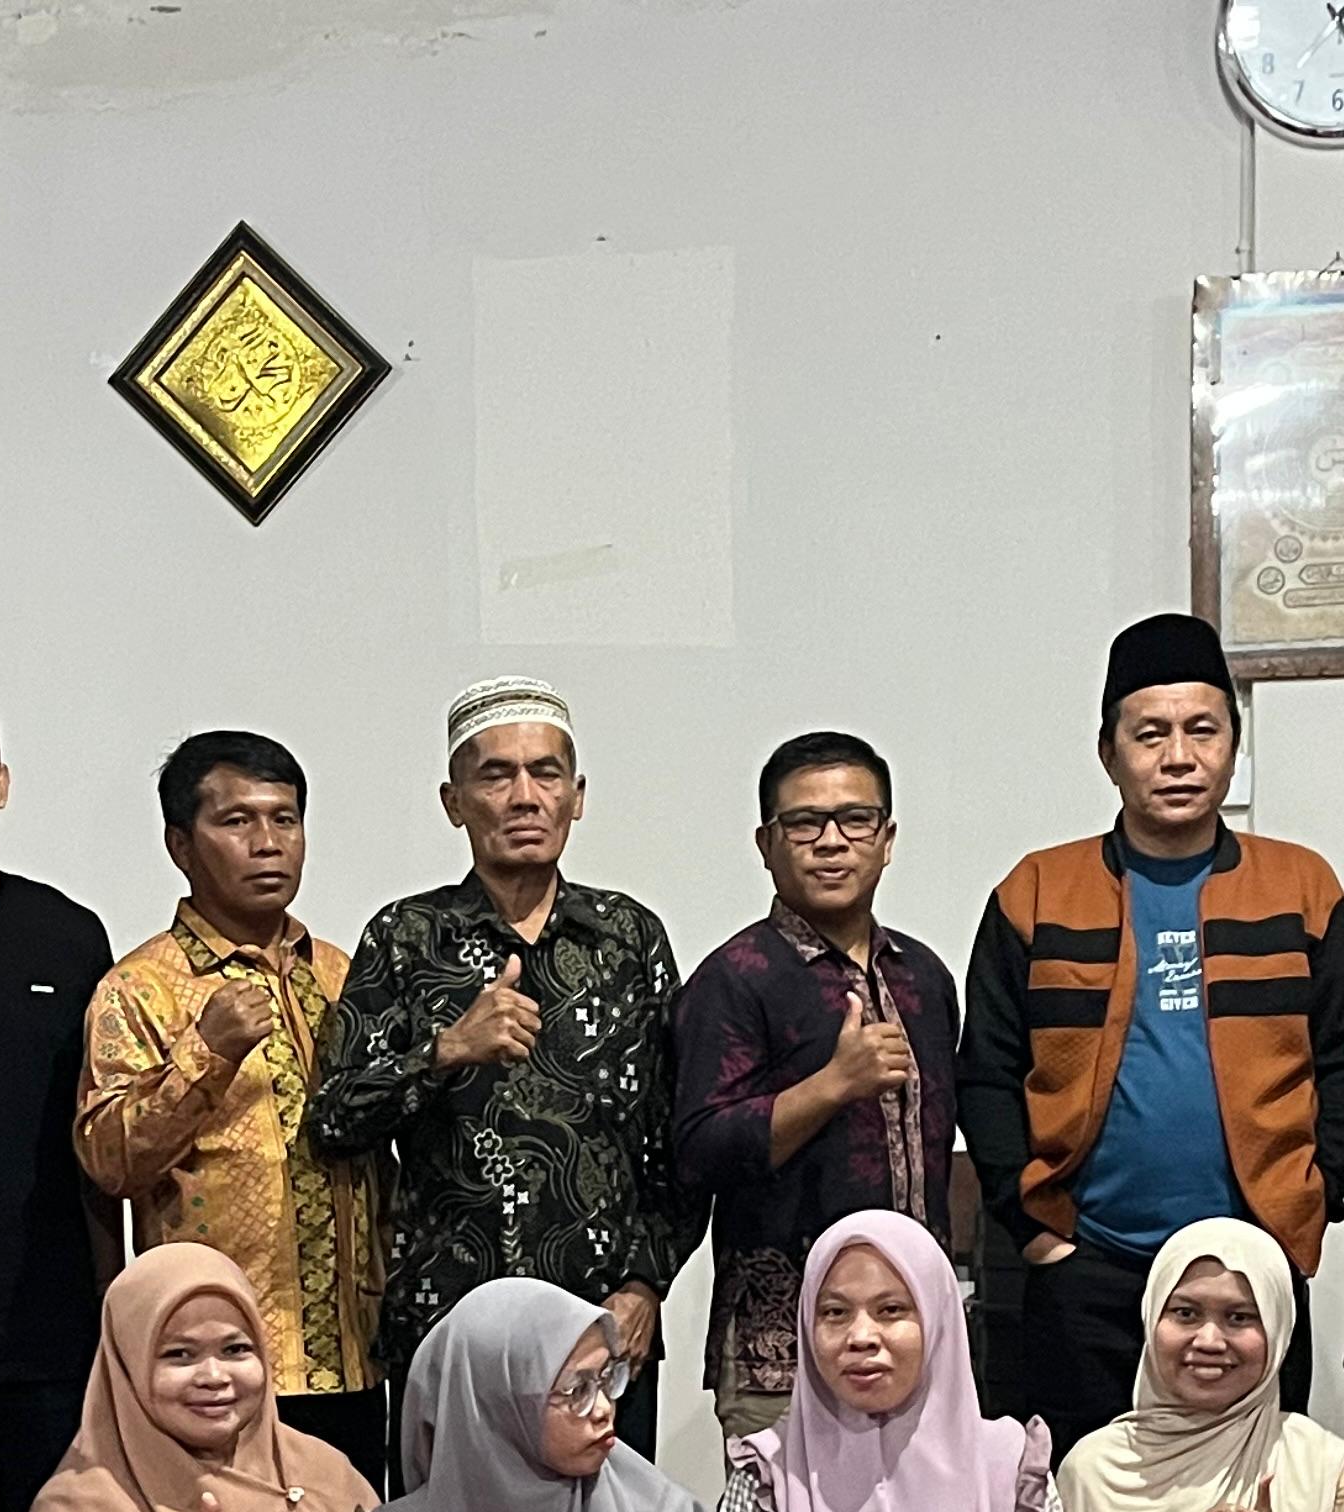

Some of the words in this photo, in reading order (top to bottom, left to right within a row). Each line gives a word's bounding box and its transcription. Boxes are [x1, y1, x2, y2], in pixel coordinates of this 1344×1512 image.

[1261, 52, 1275, 75] 8
[1293, 80, 1305, 103] 7
[1331, 88, 1344, 111] 6
